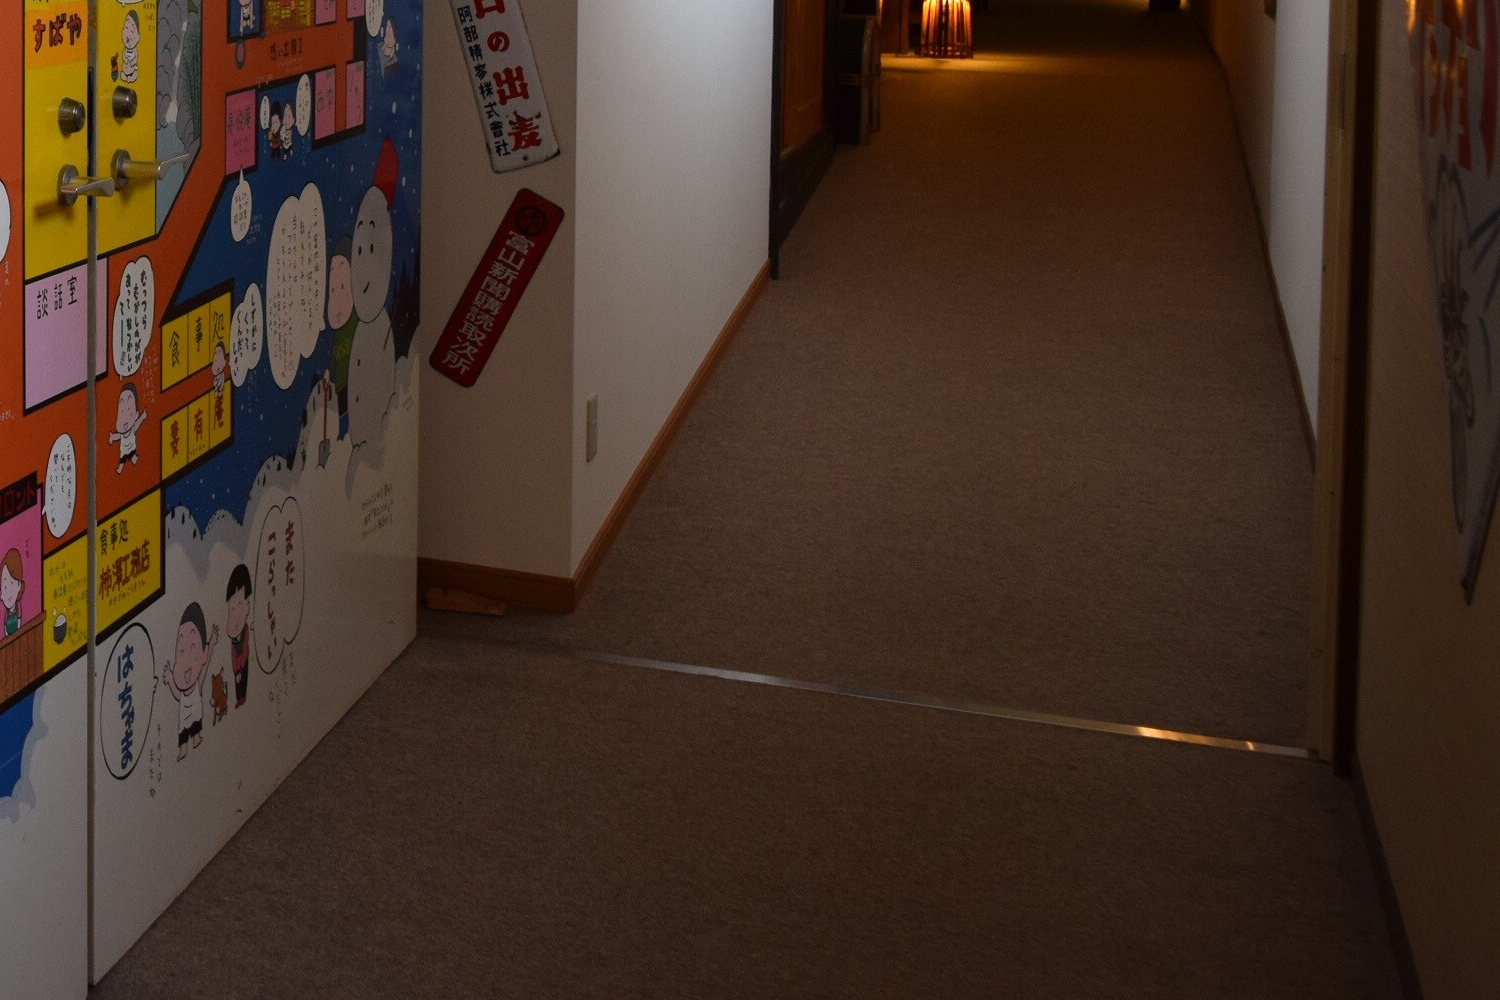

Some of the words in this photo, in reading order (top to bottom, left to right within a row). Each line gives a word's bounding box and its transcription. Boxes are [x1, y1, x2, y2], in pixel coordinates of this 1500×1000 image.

[32, 14, 83, 53] すばや
[36, 274, 78, 321] 談話室
[168, 309, 226, 369] 食事処
[100, 519, 129, 556] 食事処
